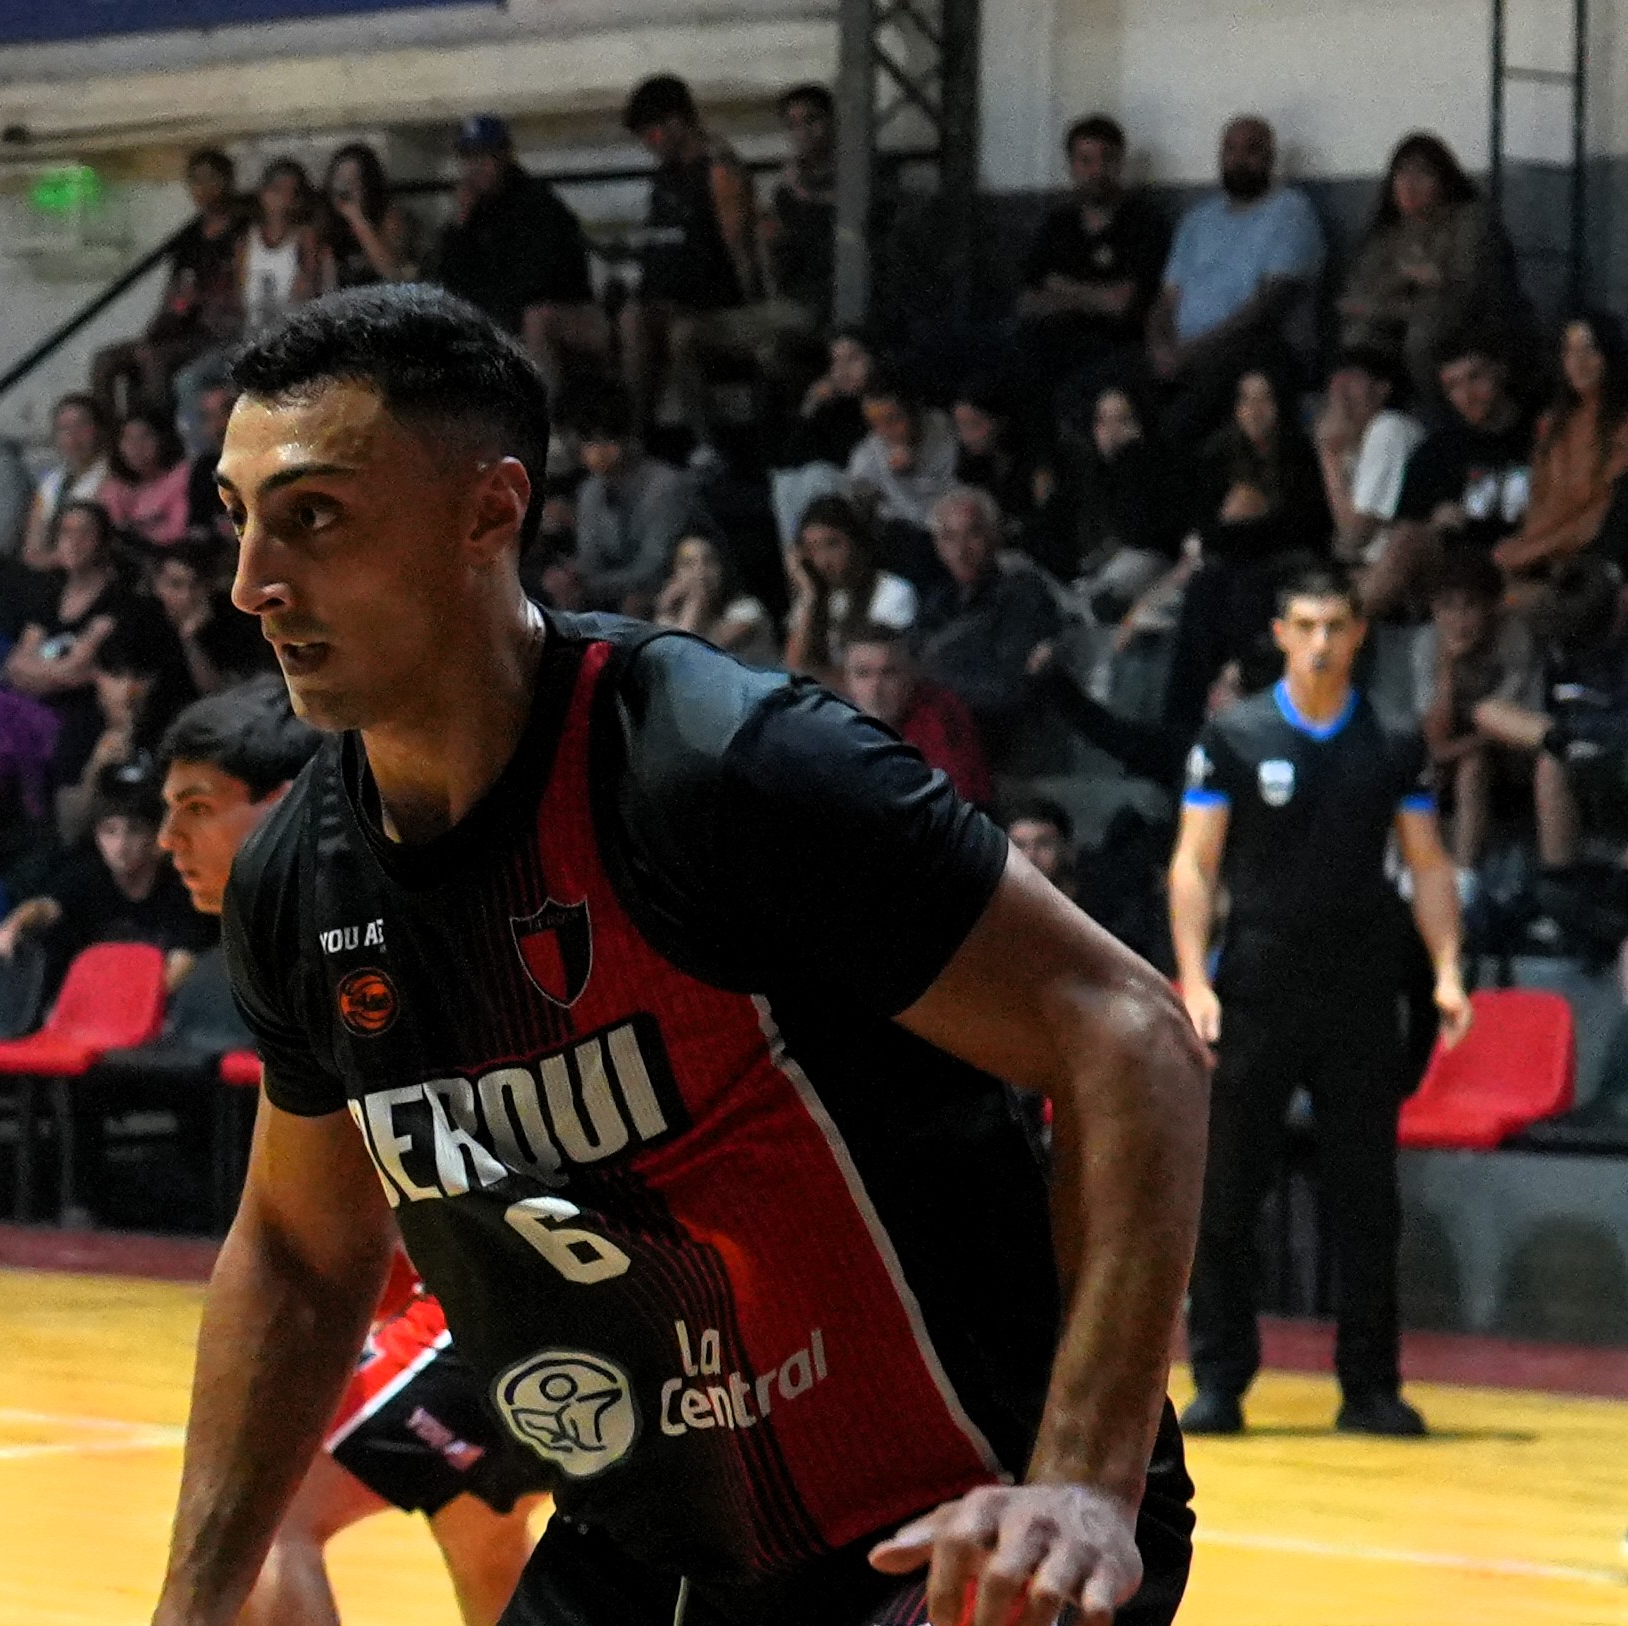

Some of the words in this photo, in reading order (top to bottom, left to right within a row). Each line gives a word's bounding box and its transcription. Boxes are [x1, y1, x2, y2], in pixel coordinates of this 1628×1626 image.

[319, 928, 359, 954] YOU
[504, 1196, 631, 1284] 6
[660, 1327, 829, 1437] Central
[674, 1319, 722, 1377] La
